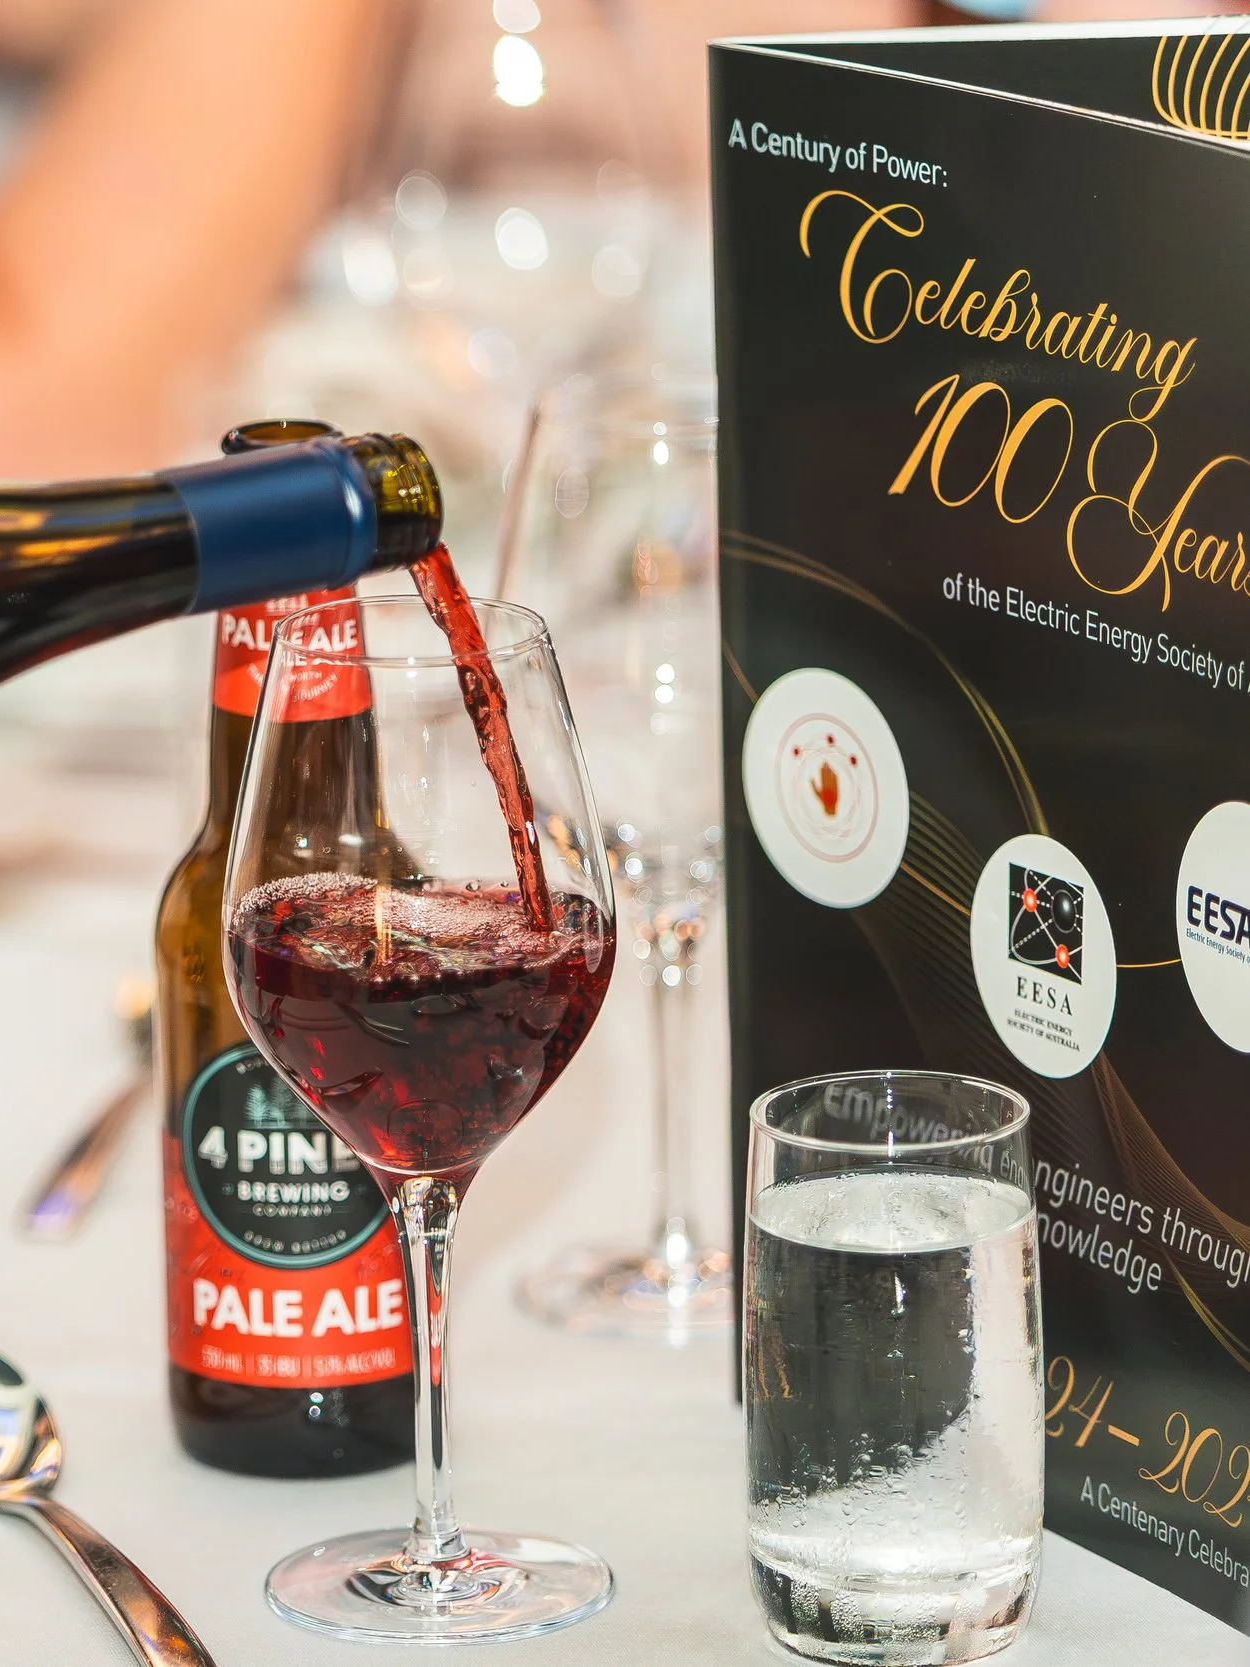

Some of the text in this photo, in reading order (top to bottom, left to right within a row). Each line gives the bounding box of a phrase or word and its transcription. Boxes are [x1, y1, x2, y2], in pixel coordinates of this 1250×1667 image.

[728, 118, 948, 188] A Century of Power:
[799, 190, 1197, 421] Celebrating
[888, 374, 1073, 523] 100
[308, 618, 358, 653] ALE
[943, 572, 1245, 690] of the Electric Energy Society of
[1186, 927, 1206, 945] Electric
[1206, 936, 1225, 955] Energy
[1226, 945, 1245, 964] Society
[1016, 976, 1073, 1017] EESA
[198, 1125, 228, 1169] 4
[237, 1180, 351, 1204] BREWING
[1037, 1210, 1162, 1295] nowledge
[193, 1277, 404, 1338] PALE ALE
[1080, 1475, 1095, 1507] A
[1097, 1483, 1185, 1557] Centenary
